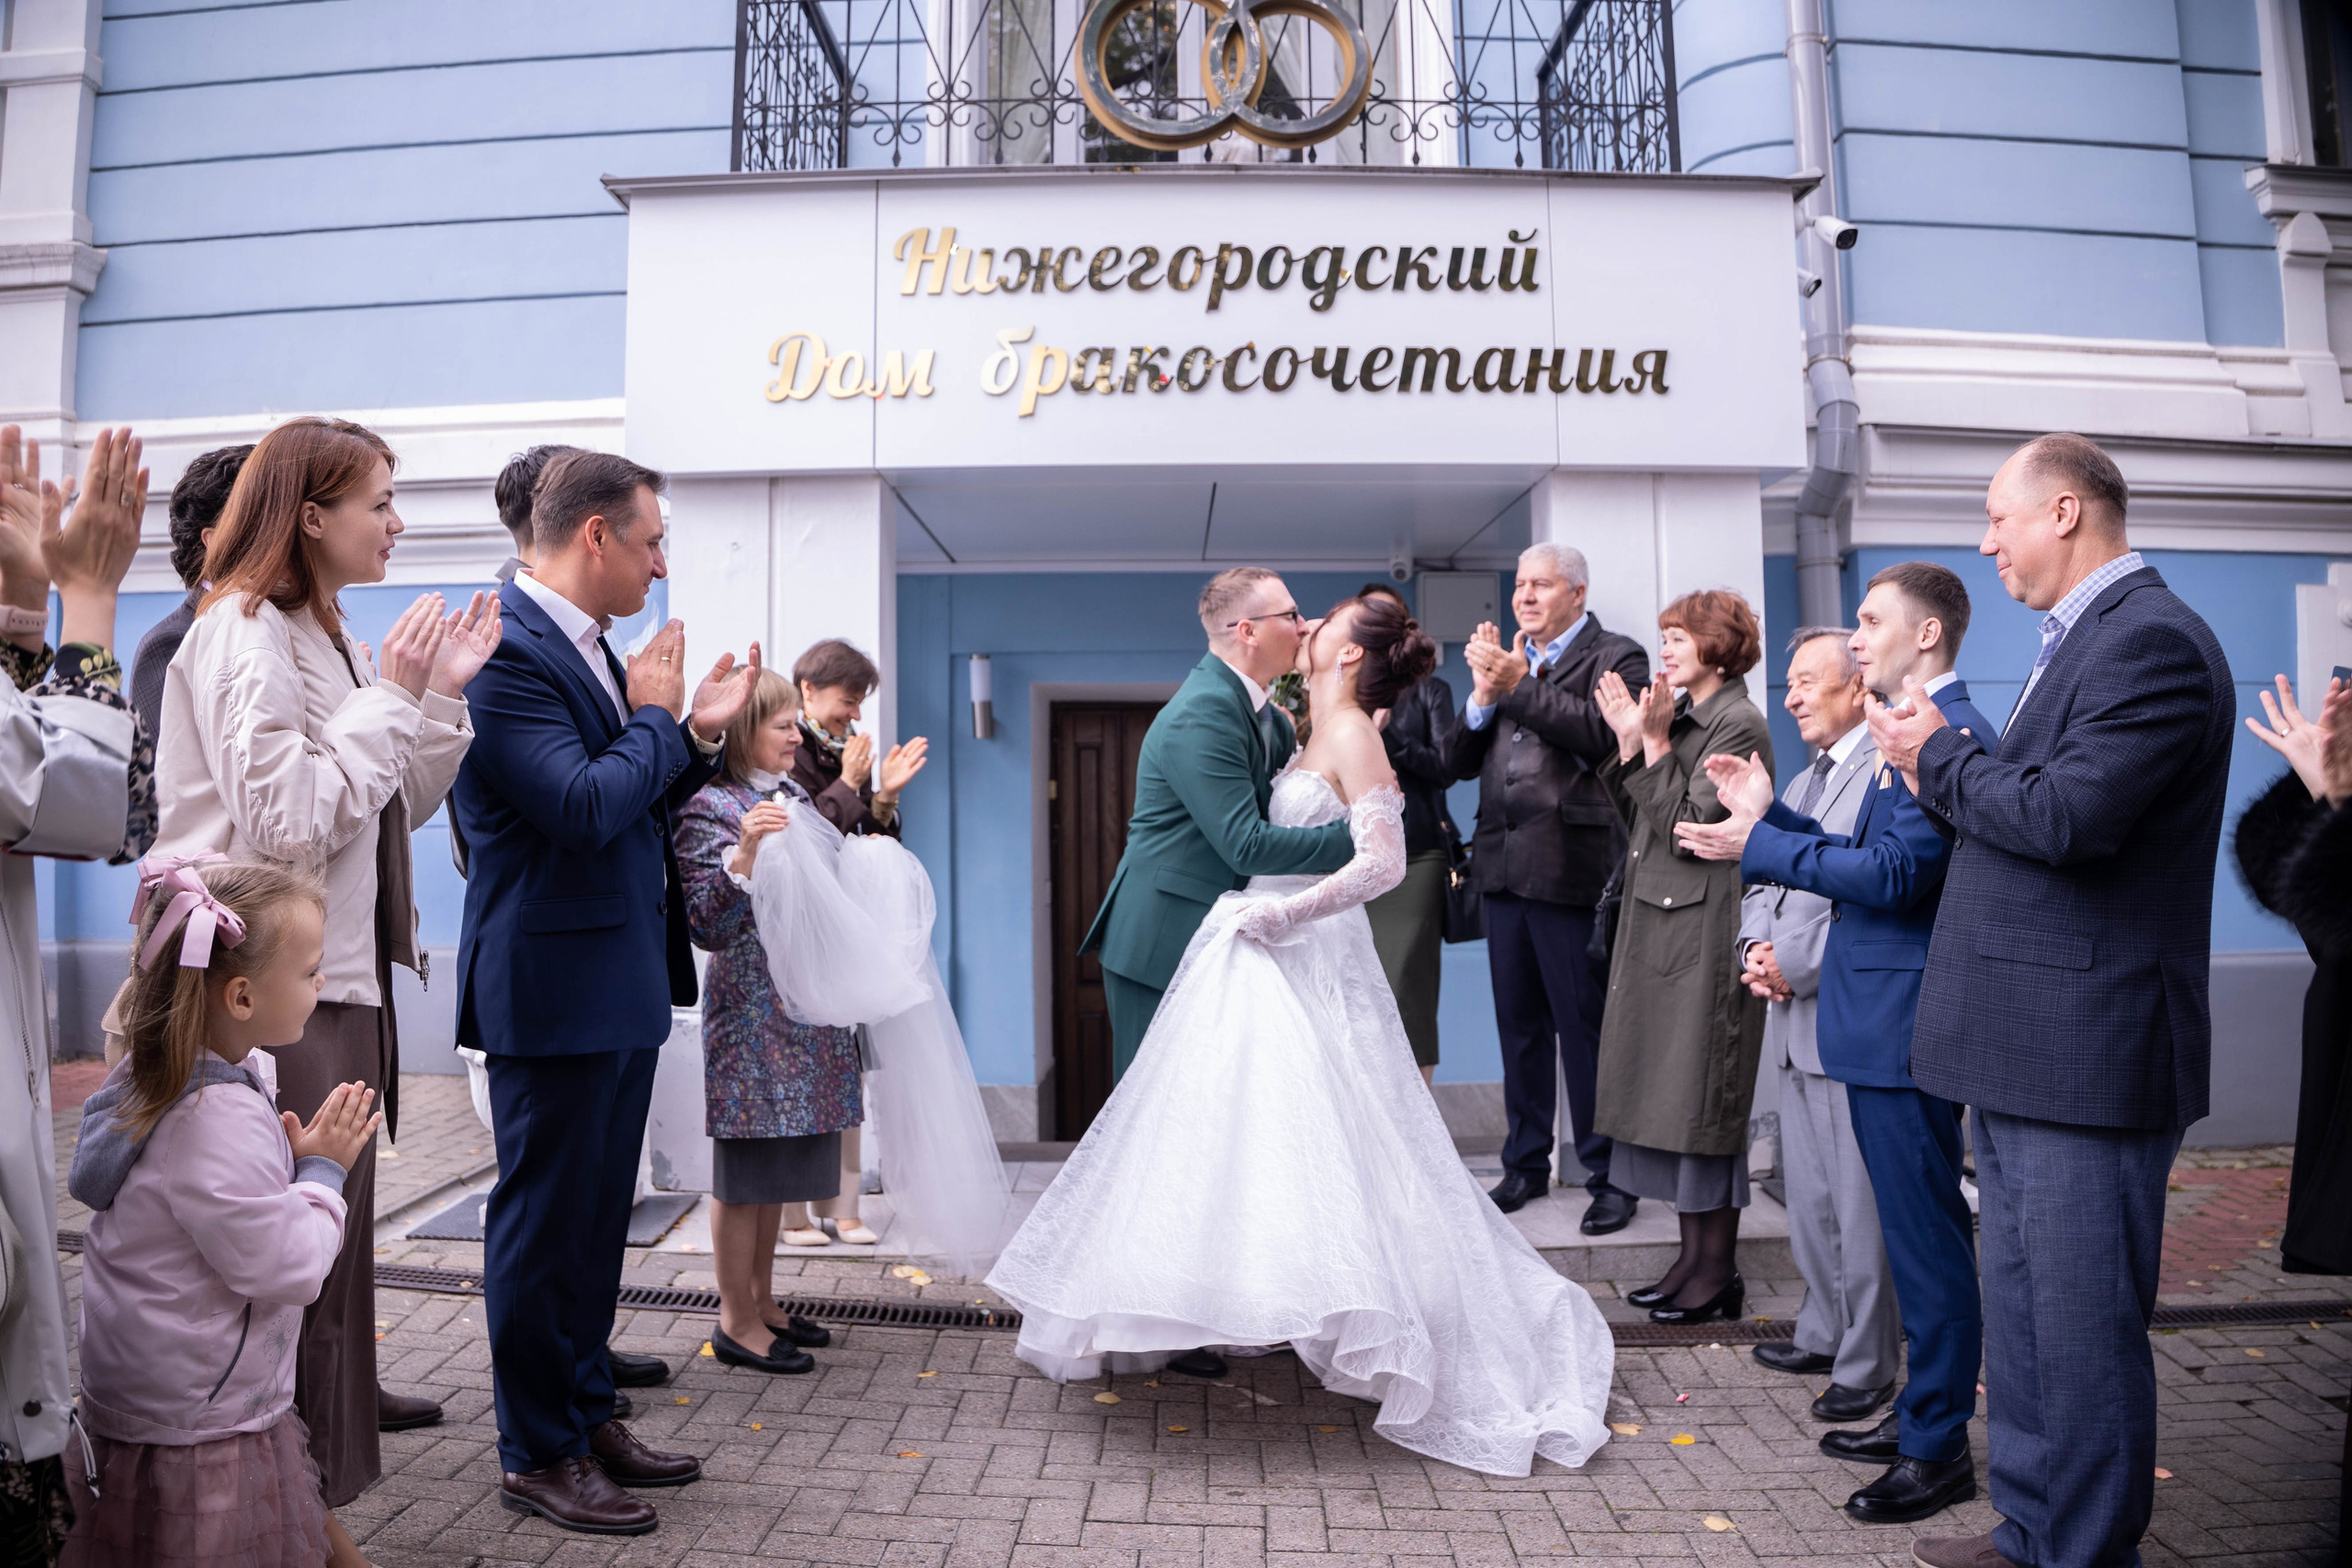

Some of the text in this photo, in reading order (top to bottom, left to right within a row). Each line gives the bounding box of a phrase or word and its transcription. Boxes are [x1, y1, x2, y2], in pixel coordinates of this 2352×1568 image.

[895, 226, 1540, 312] Нижегородский
[765, 326, 1669, 418] Дом бракосочетания
